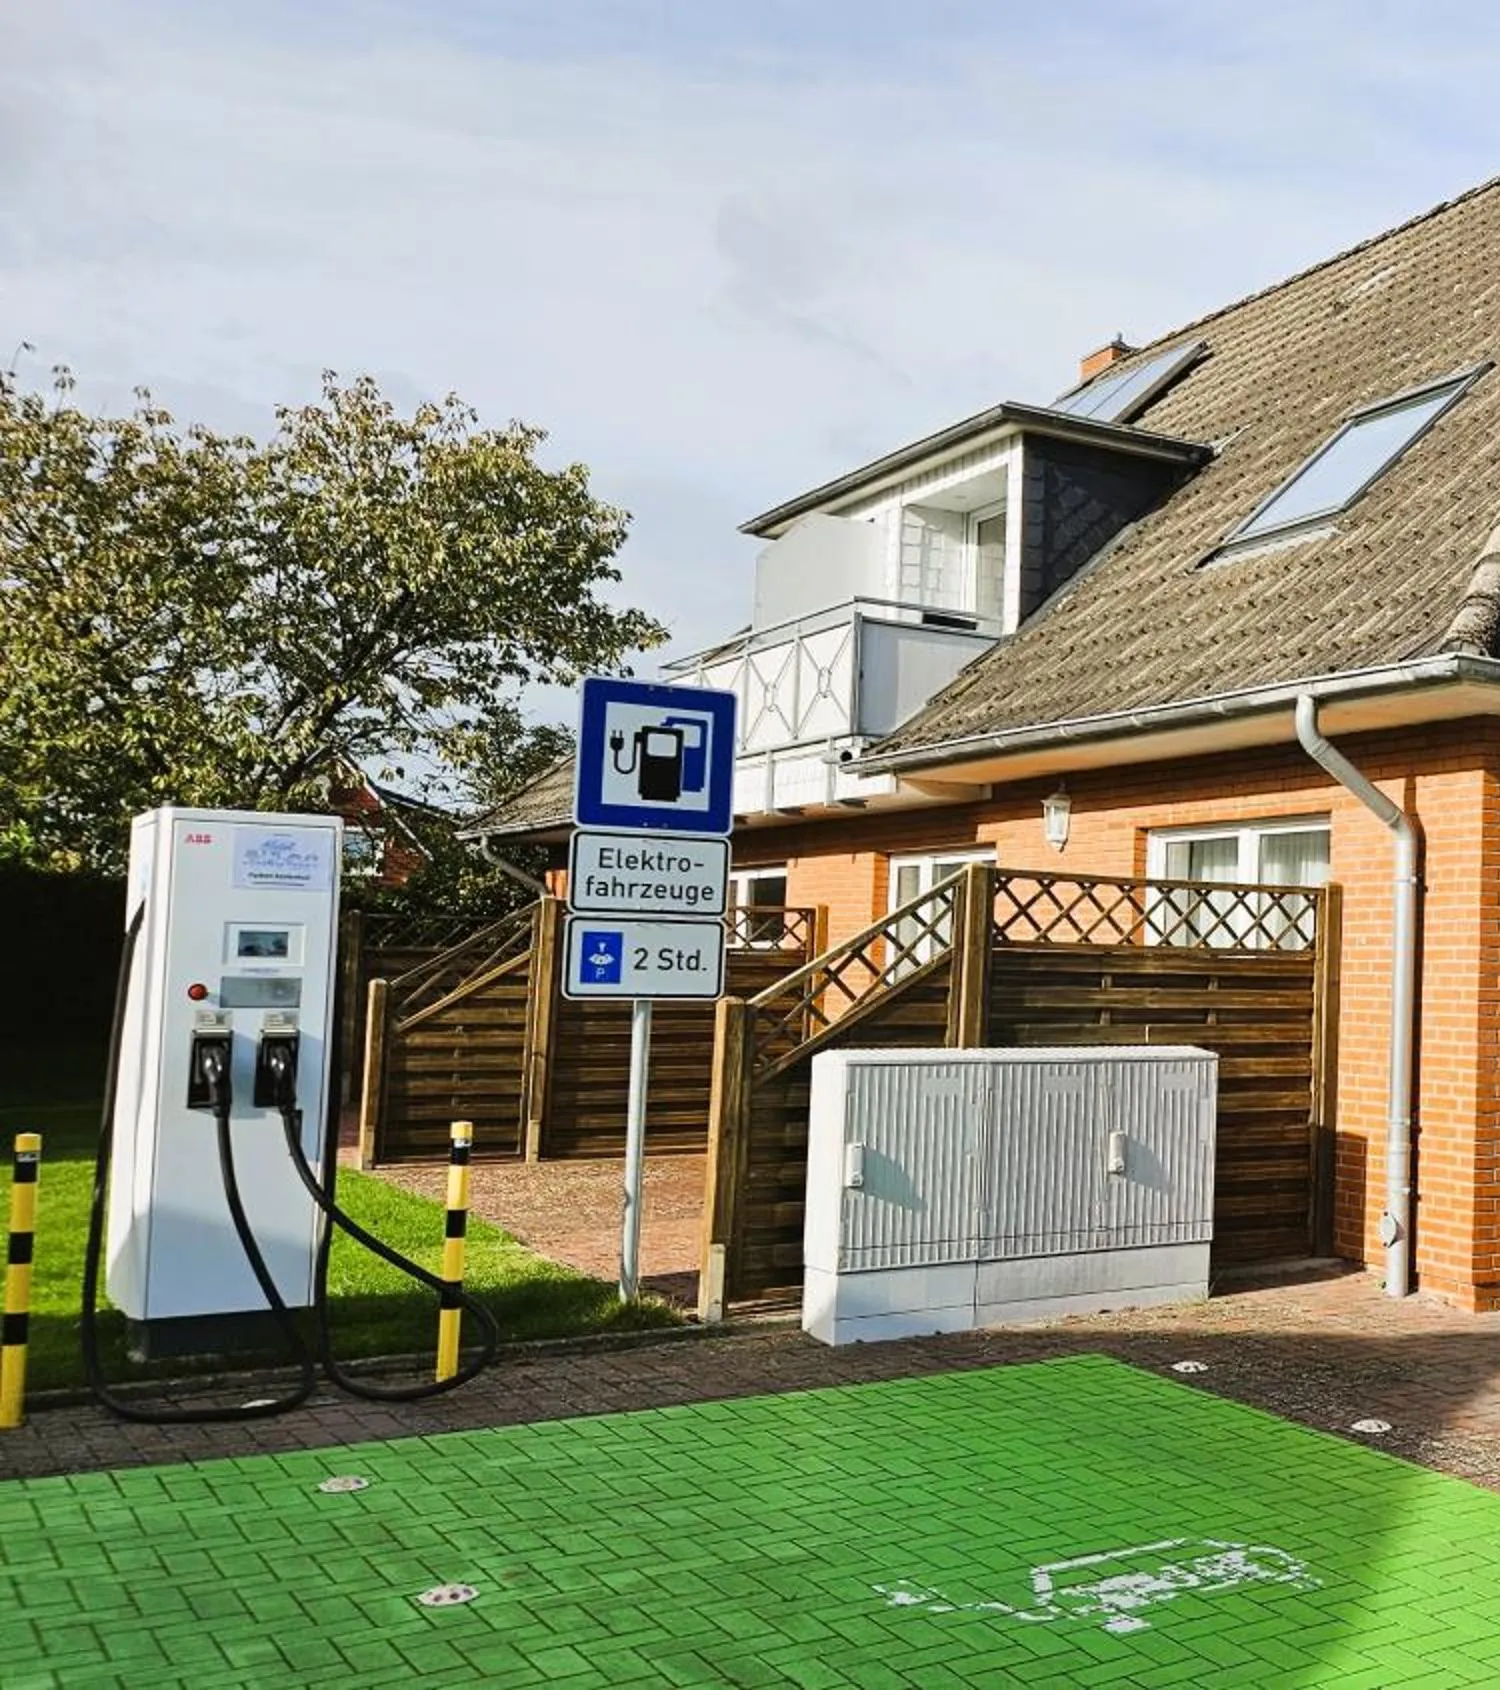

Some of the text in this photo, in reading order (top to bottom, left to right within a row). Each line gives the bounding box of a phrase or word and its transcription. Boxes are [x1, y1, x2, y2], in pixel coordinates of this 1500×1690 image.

[599, 847, 705, 873] Elektro-
[586, 875, 714, 906] fahrzeuge
[634, 948, 707, 972] 2 Std.
